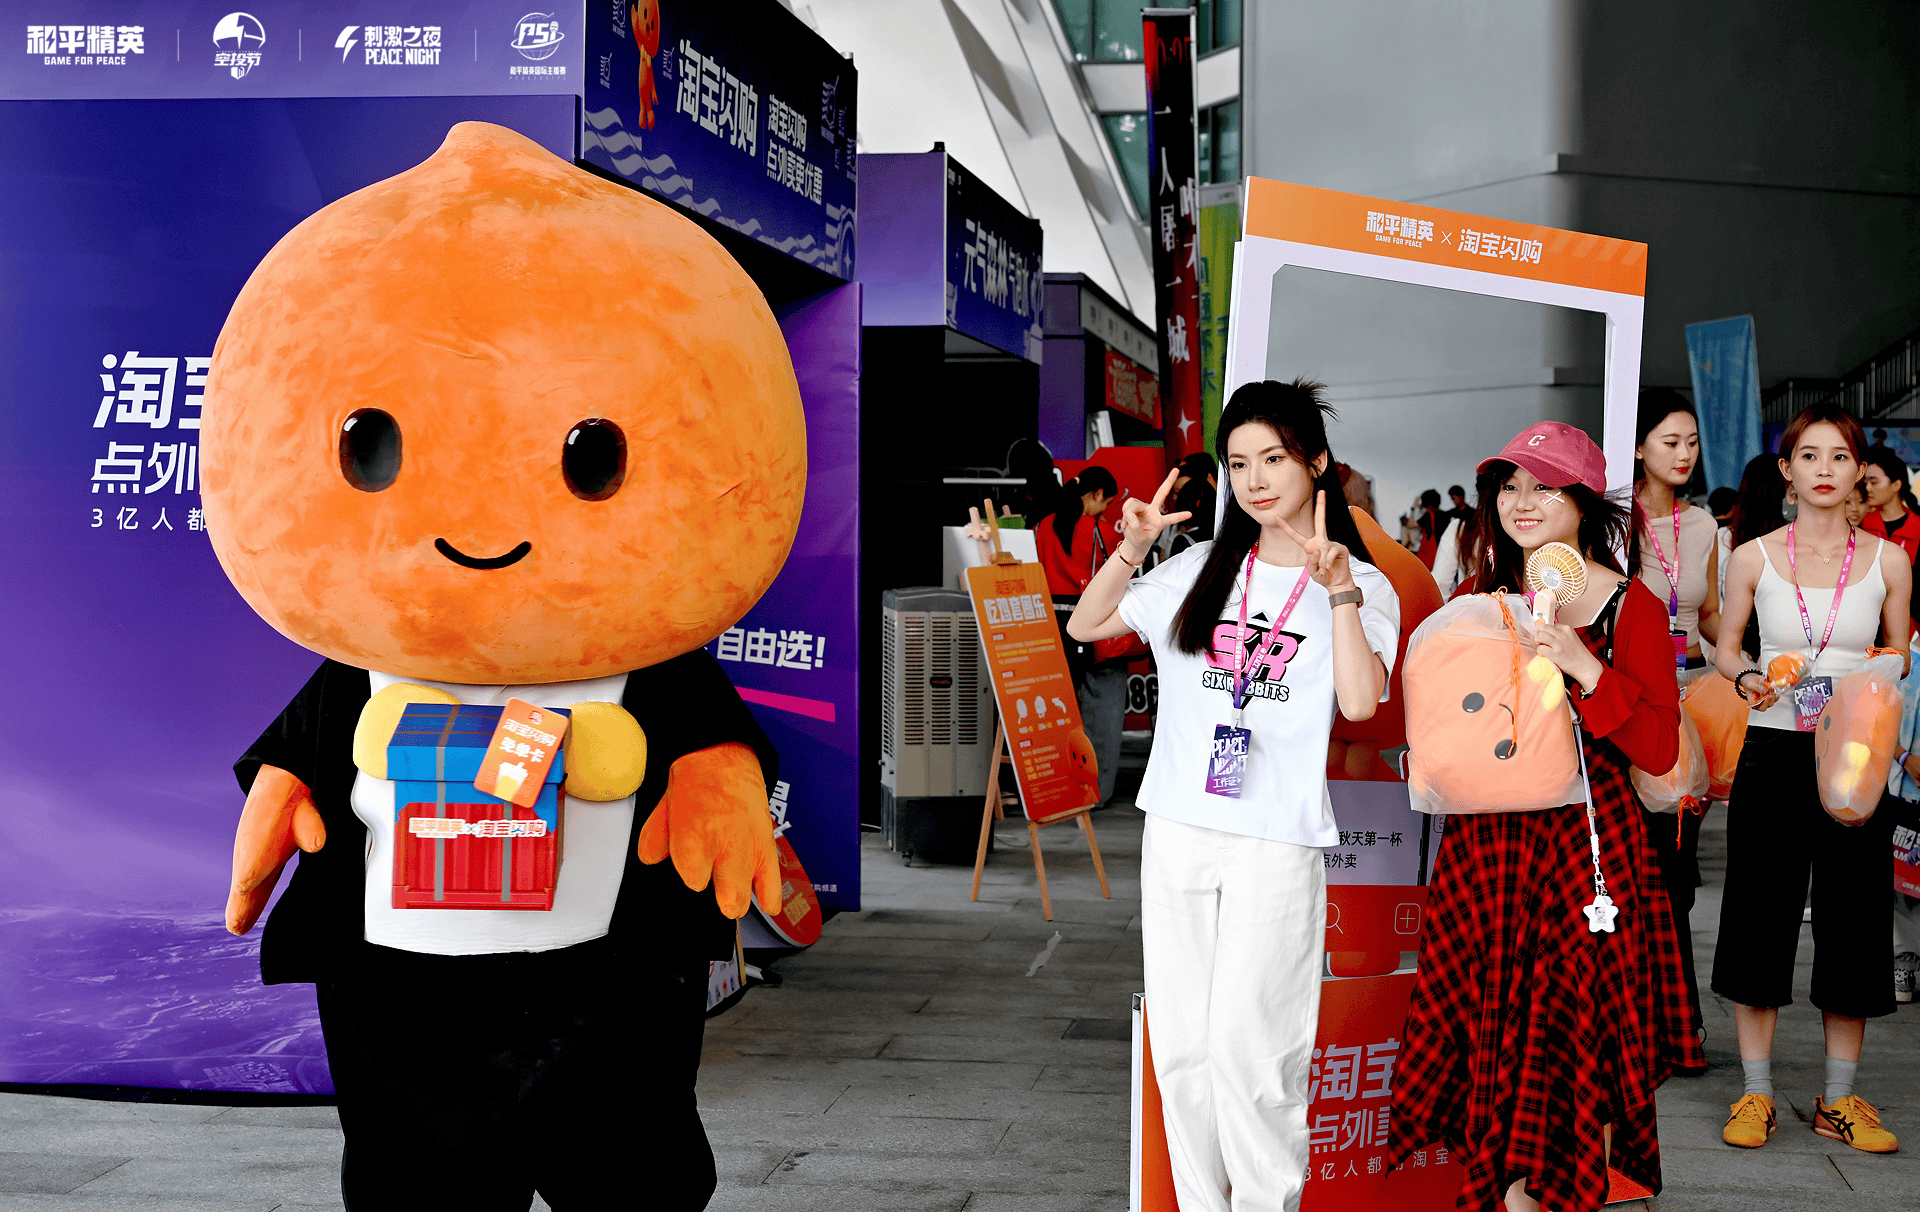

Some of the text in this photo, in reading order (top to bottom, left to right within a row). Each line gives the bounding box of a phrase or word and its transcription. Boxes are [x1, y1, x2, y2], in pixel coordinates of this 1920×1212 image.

[27, 25, 145, 55] 和平精英
[364, 25, 442, 47] 刺激之夜
[44, 56, 126, 66] GAME FOR PEACE
[214, 53, 262, 67] 空投节
[364, 49, 442, 65] PEACE NIGHT
[676, 38, 758, 157] 淘宝闪购
[768, 94, 808, 153] 淘宝闪购
[1365, 210, 1435, 242] 和平精英
[1457, 228, 1543, 264] 淘宝闪购
[1375, 234, 1423, 248] GAME FOR PEACE
[1203, 670, 1290, 702] SIX RBBITS
[502, 718, 558, 747] 淘宝闪购
[499, 736, 546, 763] 免单卡
[477, 821, 545, 836] 淘宝闪购
[1338, 830, 1403, 848] 秋天第一杯
